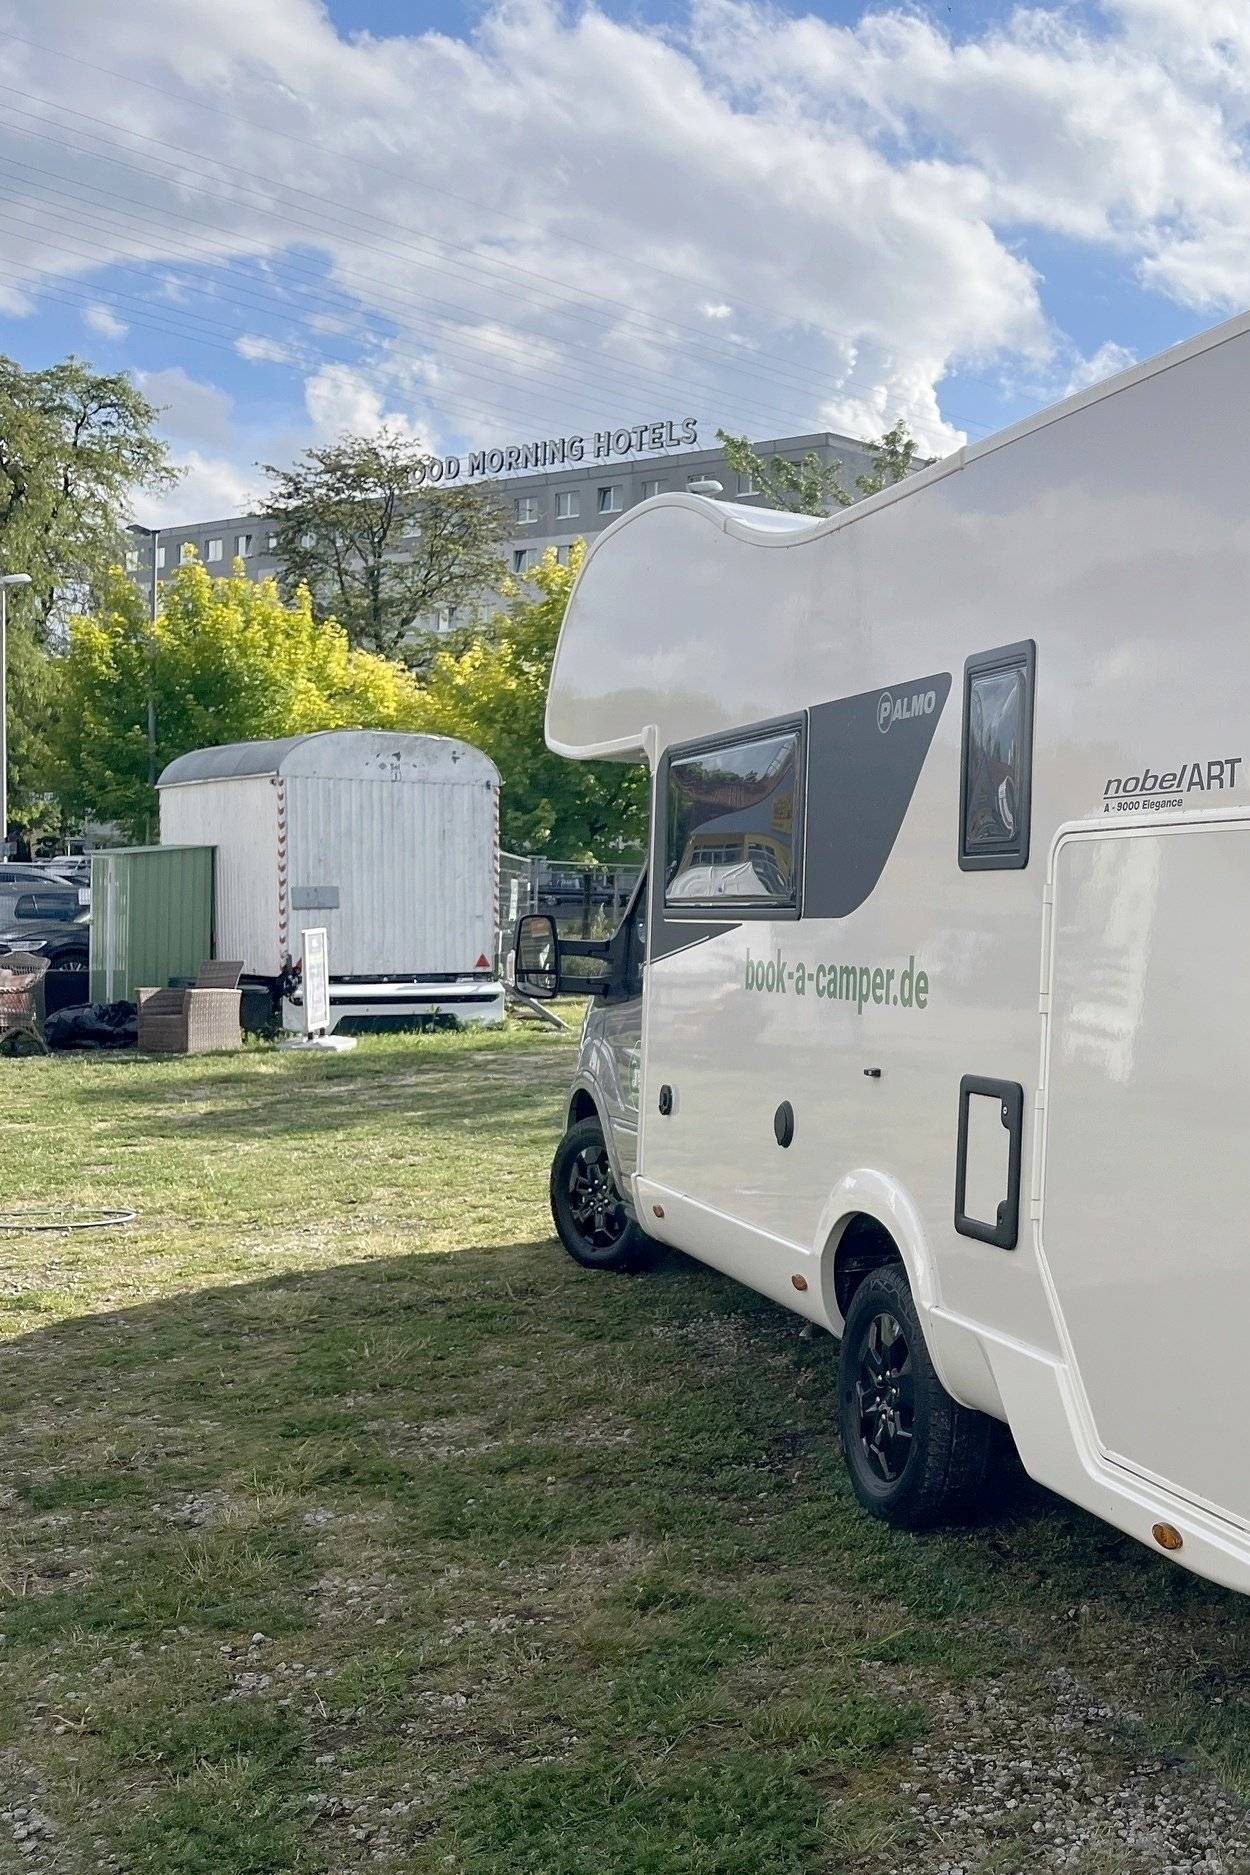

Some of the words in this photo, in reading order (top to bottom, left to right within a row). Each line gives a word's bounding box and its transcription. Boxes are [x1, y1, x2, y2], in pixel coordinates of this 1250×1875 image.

[407, 456, 460, 486] OOD
[467, 434, 584, 478] MORNING
[593, 417, 698, 458] HOTELS
[879, 691, 936, 725] PALMO
[1103, 757, 1242, 799] nobelART
[1103, 803, 1110, 813] A
[1116, 800, 1140, 812] 9000
[1142, 798, 1183, 811] Elegance
[744, 947, 929, 1015] book-a-camper.de
